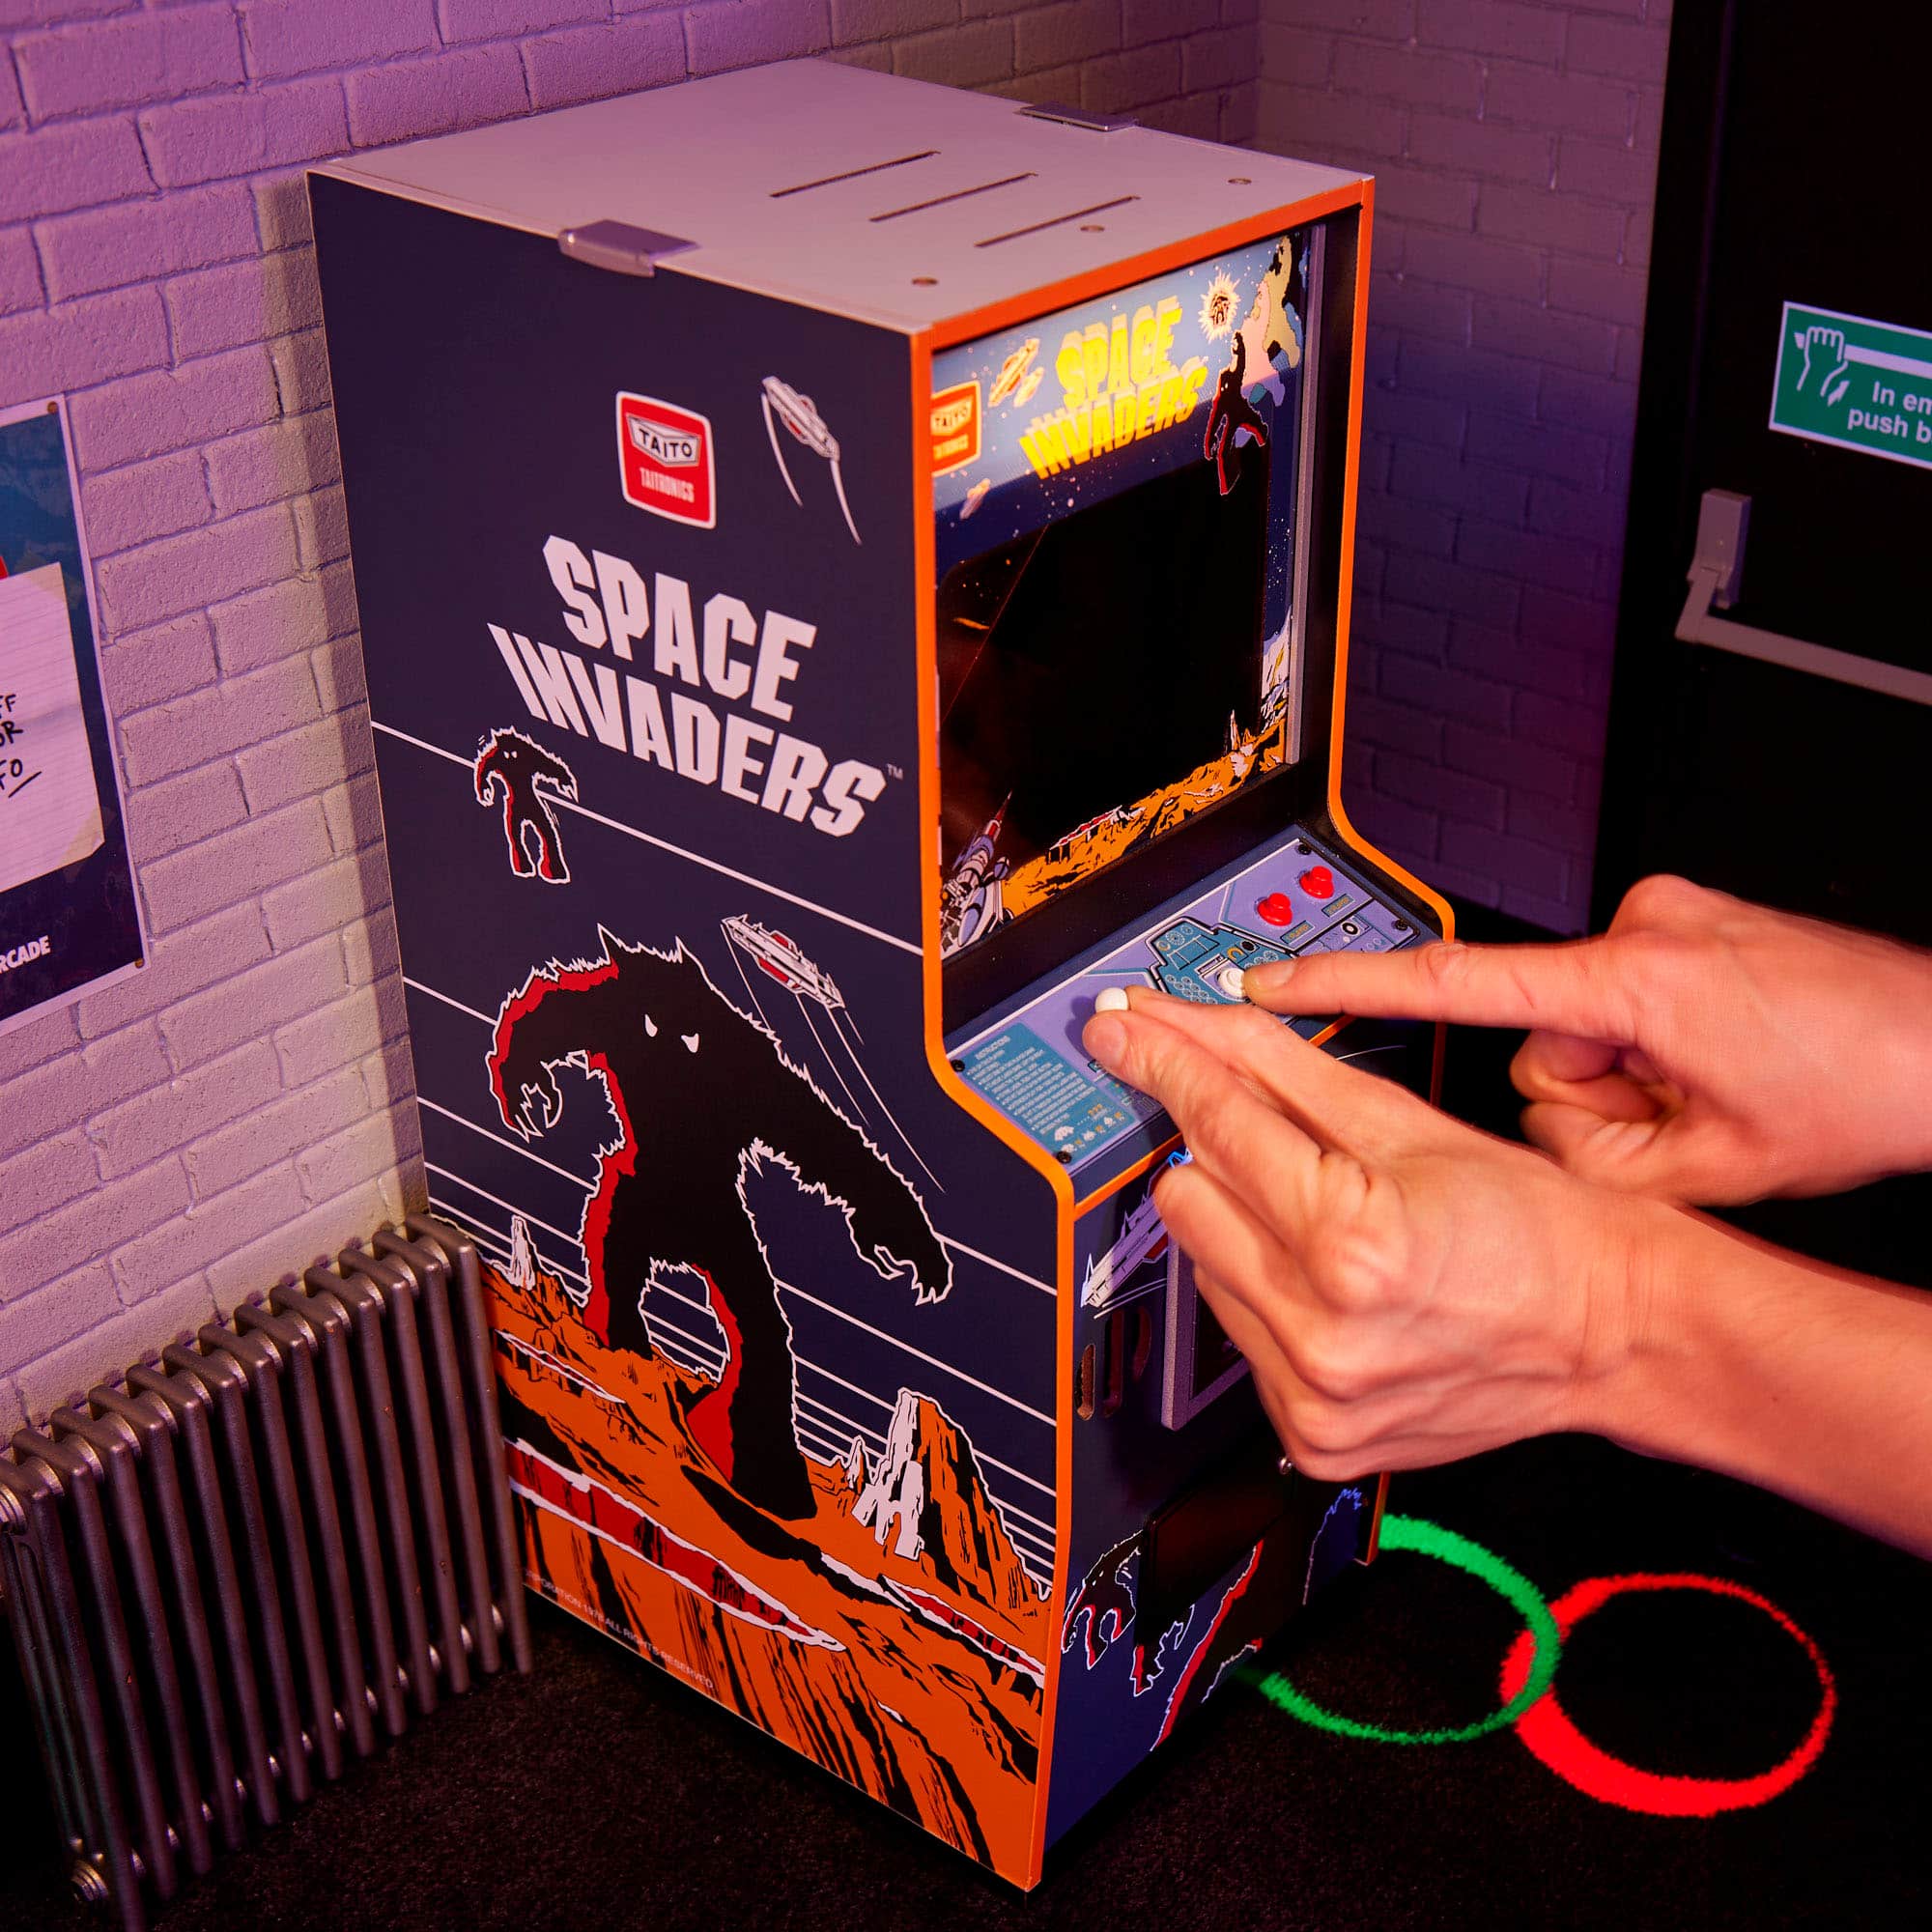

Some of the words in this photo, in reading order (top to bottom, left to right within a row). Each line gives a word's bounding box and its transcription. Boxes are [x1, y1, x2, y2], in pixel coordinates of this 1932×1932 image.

[1055, 296, 1183, 411] SPACE
[1019, 357, 1208, 480] INVADERS
[1847, 408, 1909, 438] push
[1916, 420, 1932, 444] b
[1872, 381, 1896, 407] In
[639, 428, 693, 458] TAITO
[543, 535, 817, 723] SPACE
[487, 622, 887, 838] INVADERS
[605, 1617, 623, 1634] ALL
